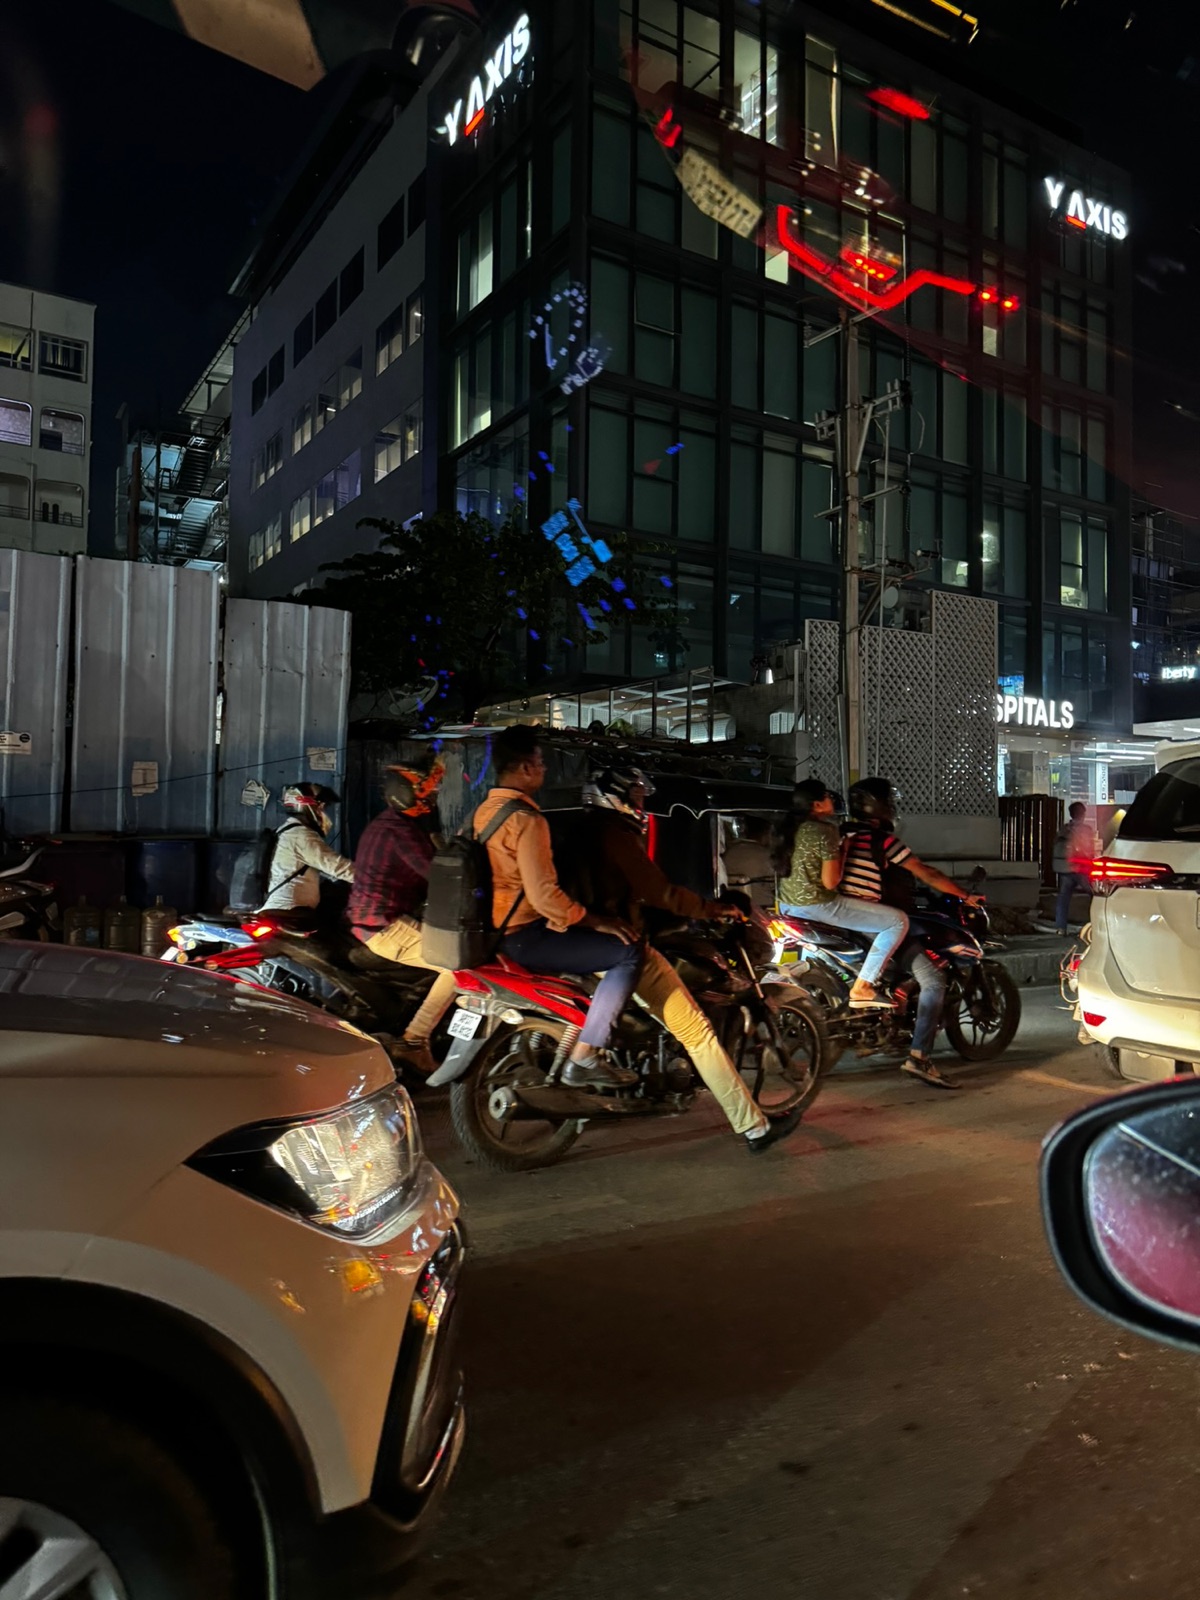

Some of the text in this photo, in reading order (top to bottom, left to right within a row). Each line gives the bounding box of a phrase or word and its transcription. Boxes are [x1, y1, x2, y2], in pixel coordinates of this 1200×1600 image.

[464, 13, 531, 137] AXIS
[1044, 176, 1129, 240] Y AXIS
